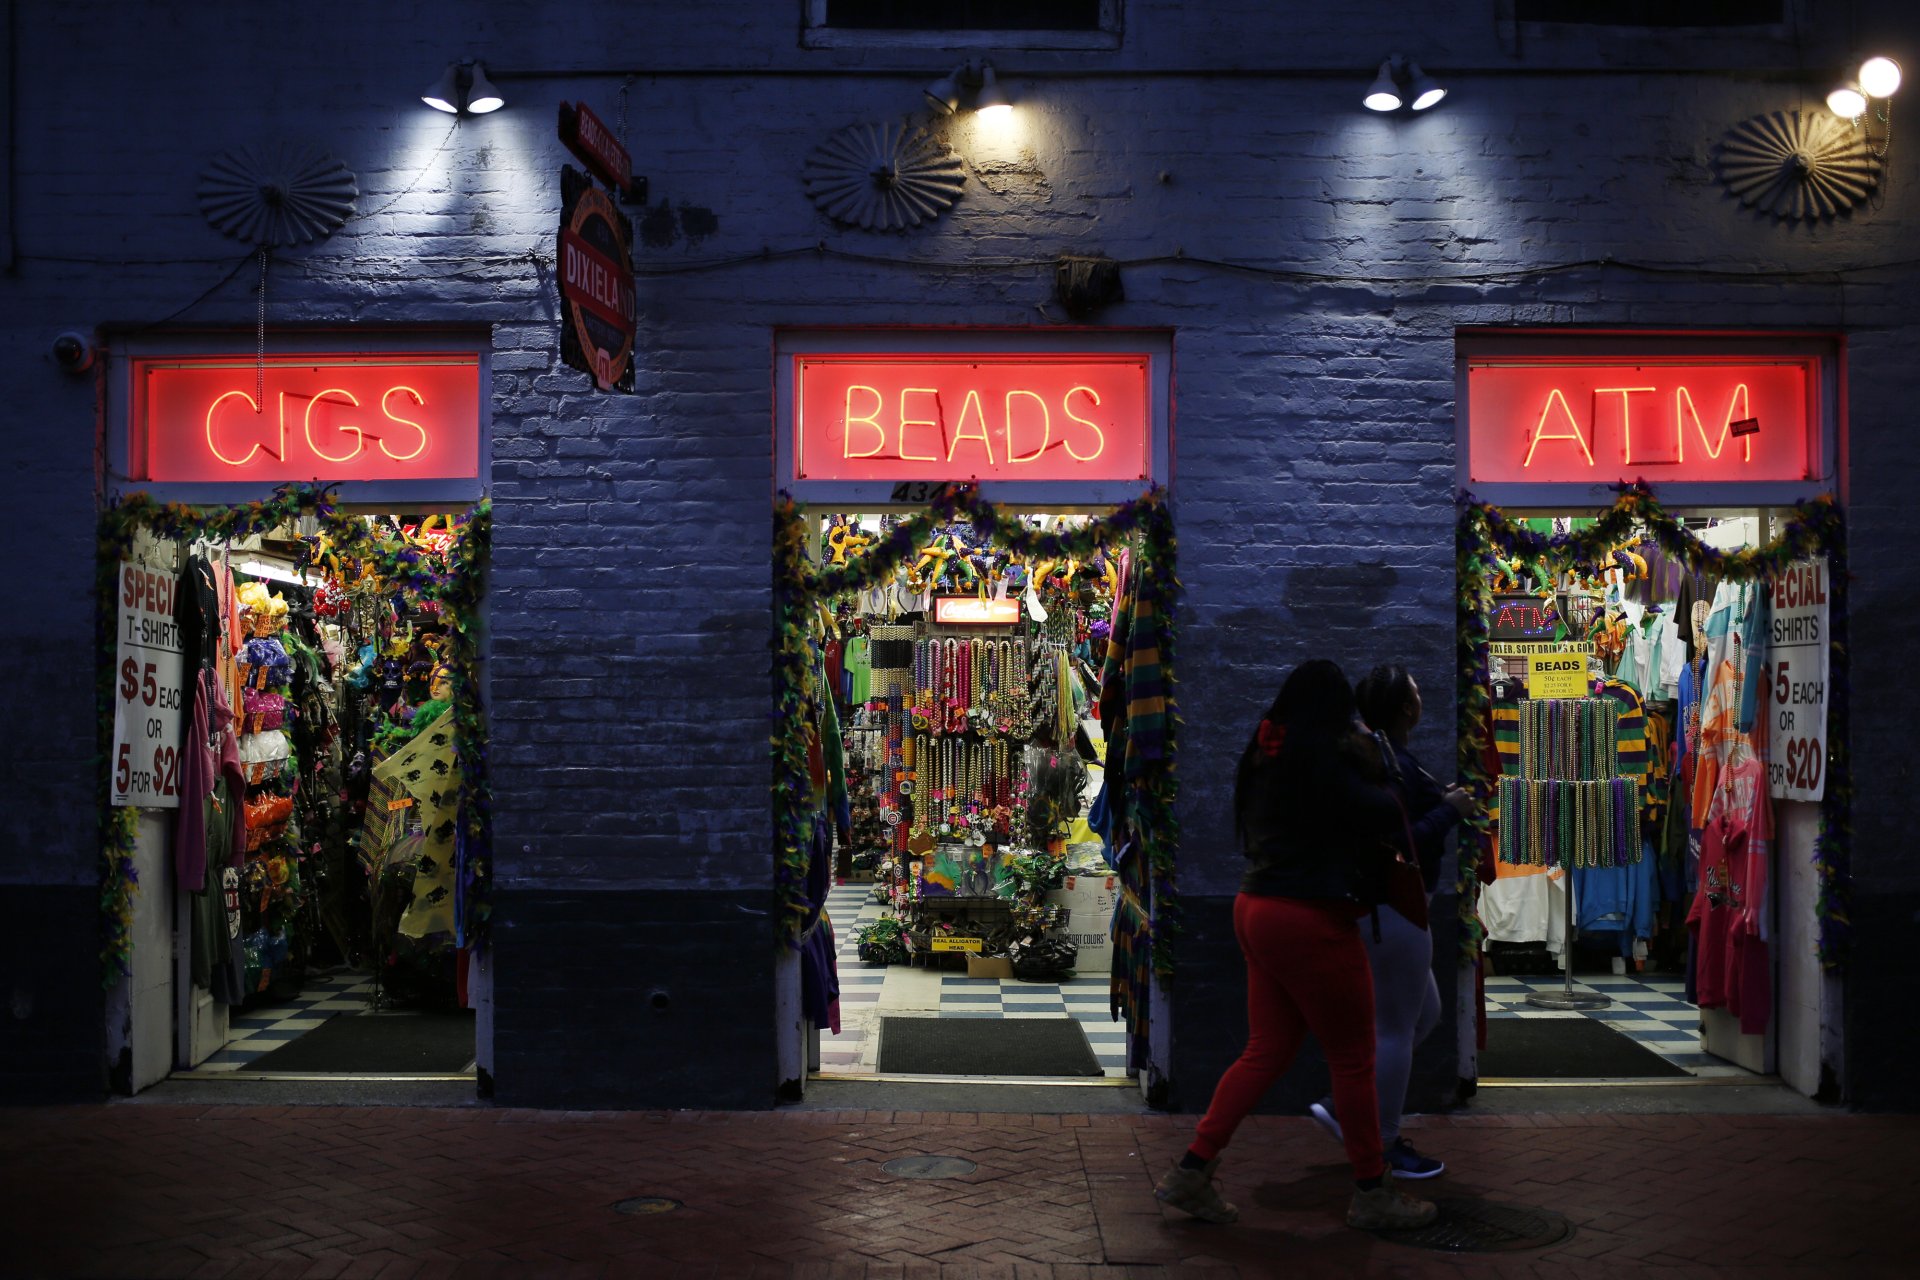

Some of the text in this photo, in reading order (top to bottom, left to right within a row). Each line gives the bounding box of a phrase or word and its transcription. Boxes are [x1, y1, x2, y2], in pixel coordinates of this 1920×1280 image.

[566, 242, 635, 322] DIXIELAND
[206, 385, 426, 465] CIGS
[843, 384, 1105, 464] BEADS
[1523, 383, 1752, 467] ATM
[126, 615, 185, 650] T-SHIRTS
[1496, 606, 1553, 628] ATM
[1516, 644, 1536, 654] SOFT
[1577, 643, 1594, 653] GUM
[1535, 660, 1580, 671] BEADS
[1792, 681, 1824, 705] EACH
[146, 718, 162, 738] OR
[1779, 711, 1795, 731] OR
[116, 743, 131, 794] 5
[131, 771, 151, 793] FOR
[1786, 736, 1822, 791] $20
